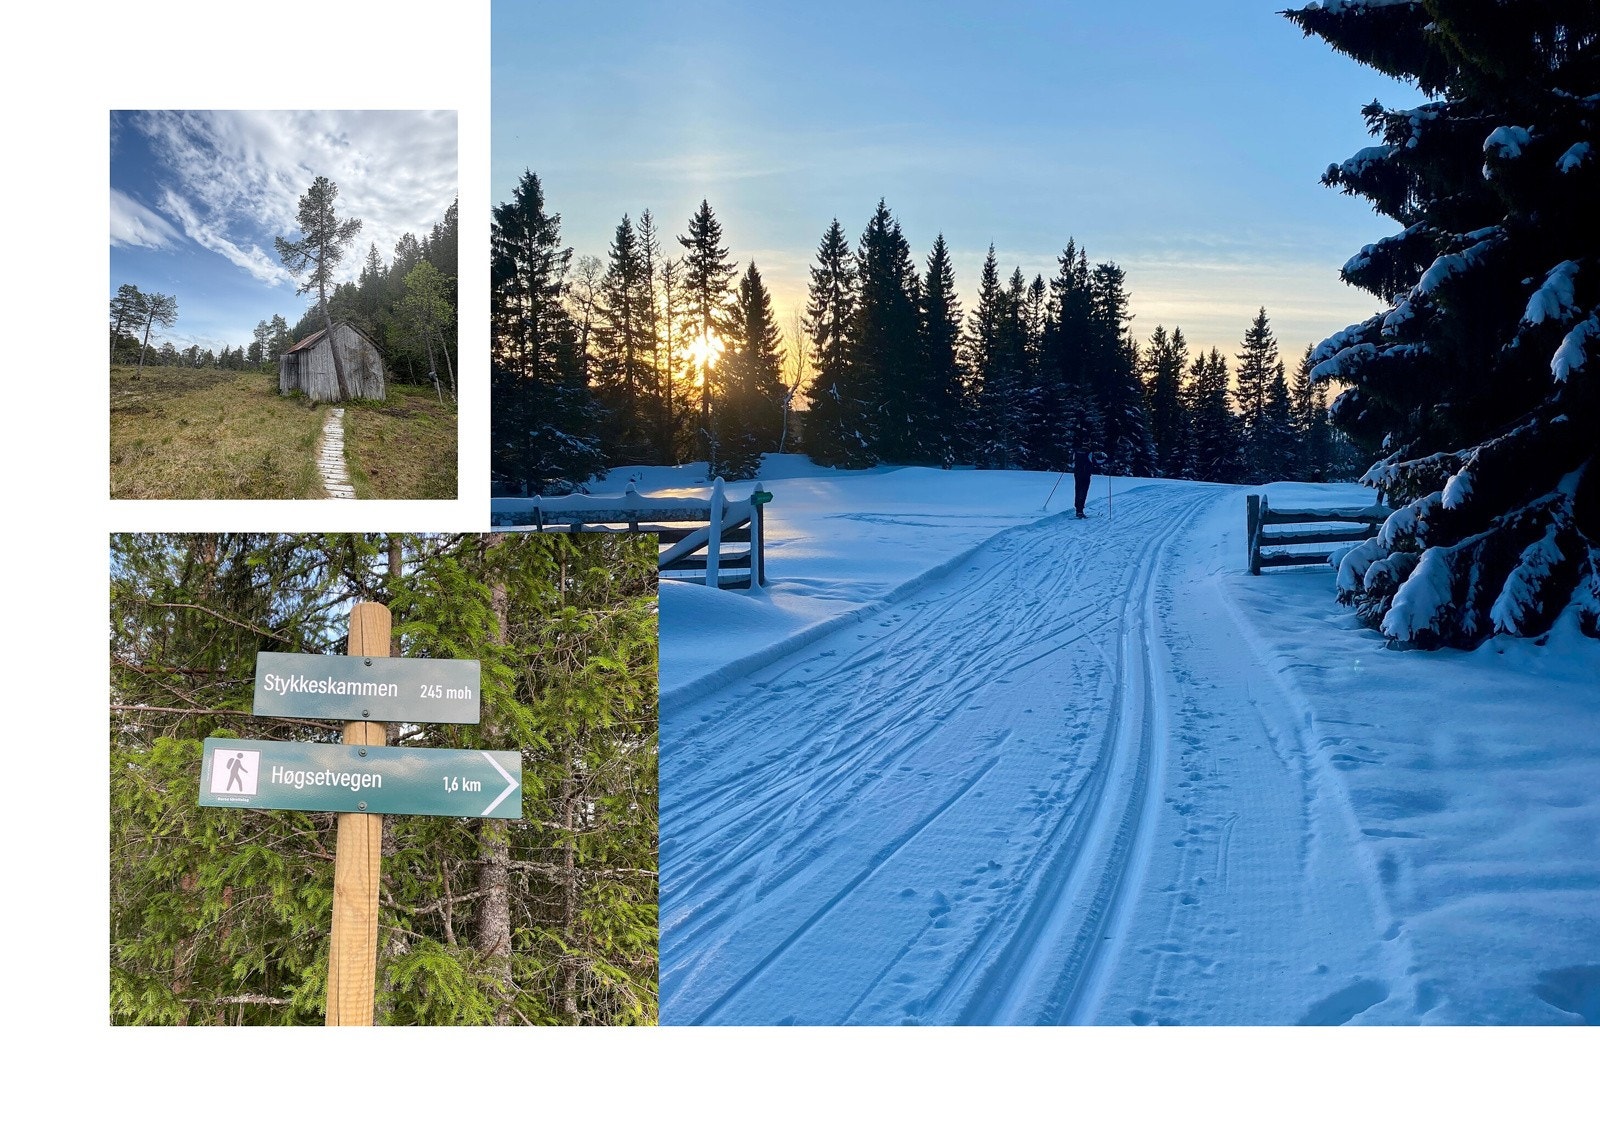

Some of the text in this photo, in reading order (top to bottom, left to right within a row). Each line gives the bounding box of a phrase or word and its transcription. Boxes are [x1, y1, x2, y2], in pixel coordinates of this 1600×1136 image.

[263, 673, 472, 700] Stykkeskammen 245 moh
[271, 766, 482, 793] Høgsetvegen 1,6 km
